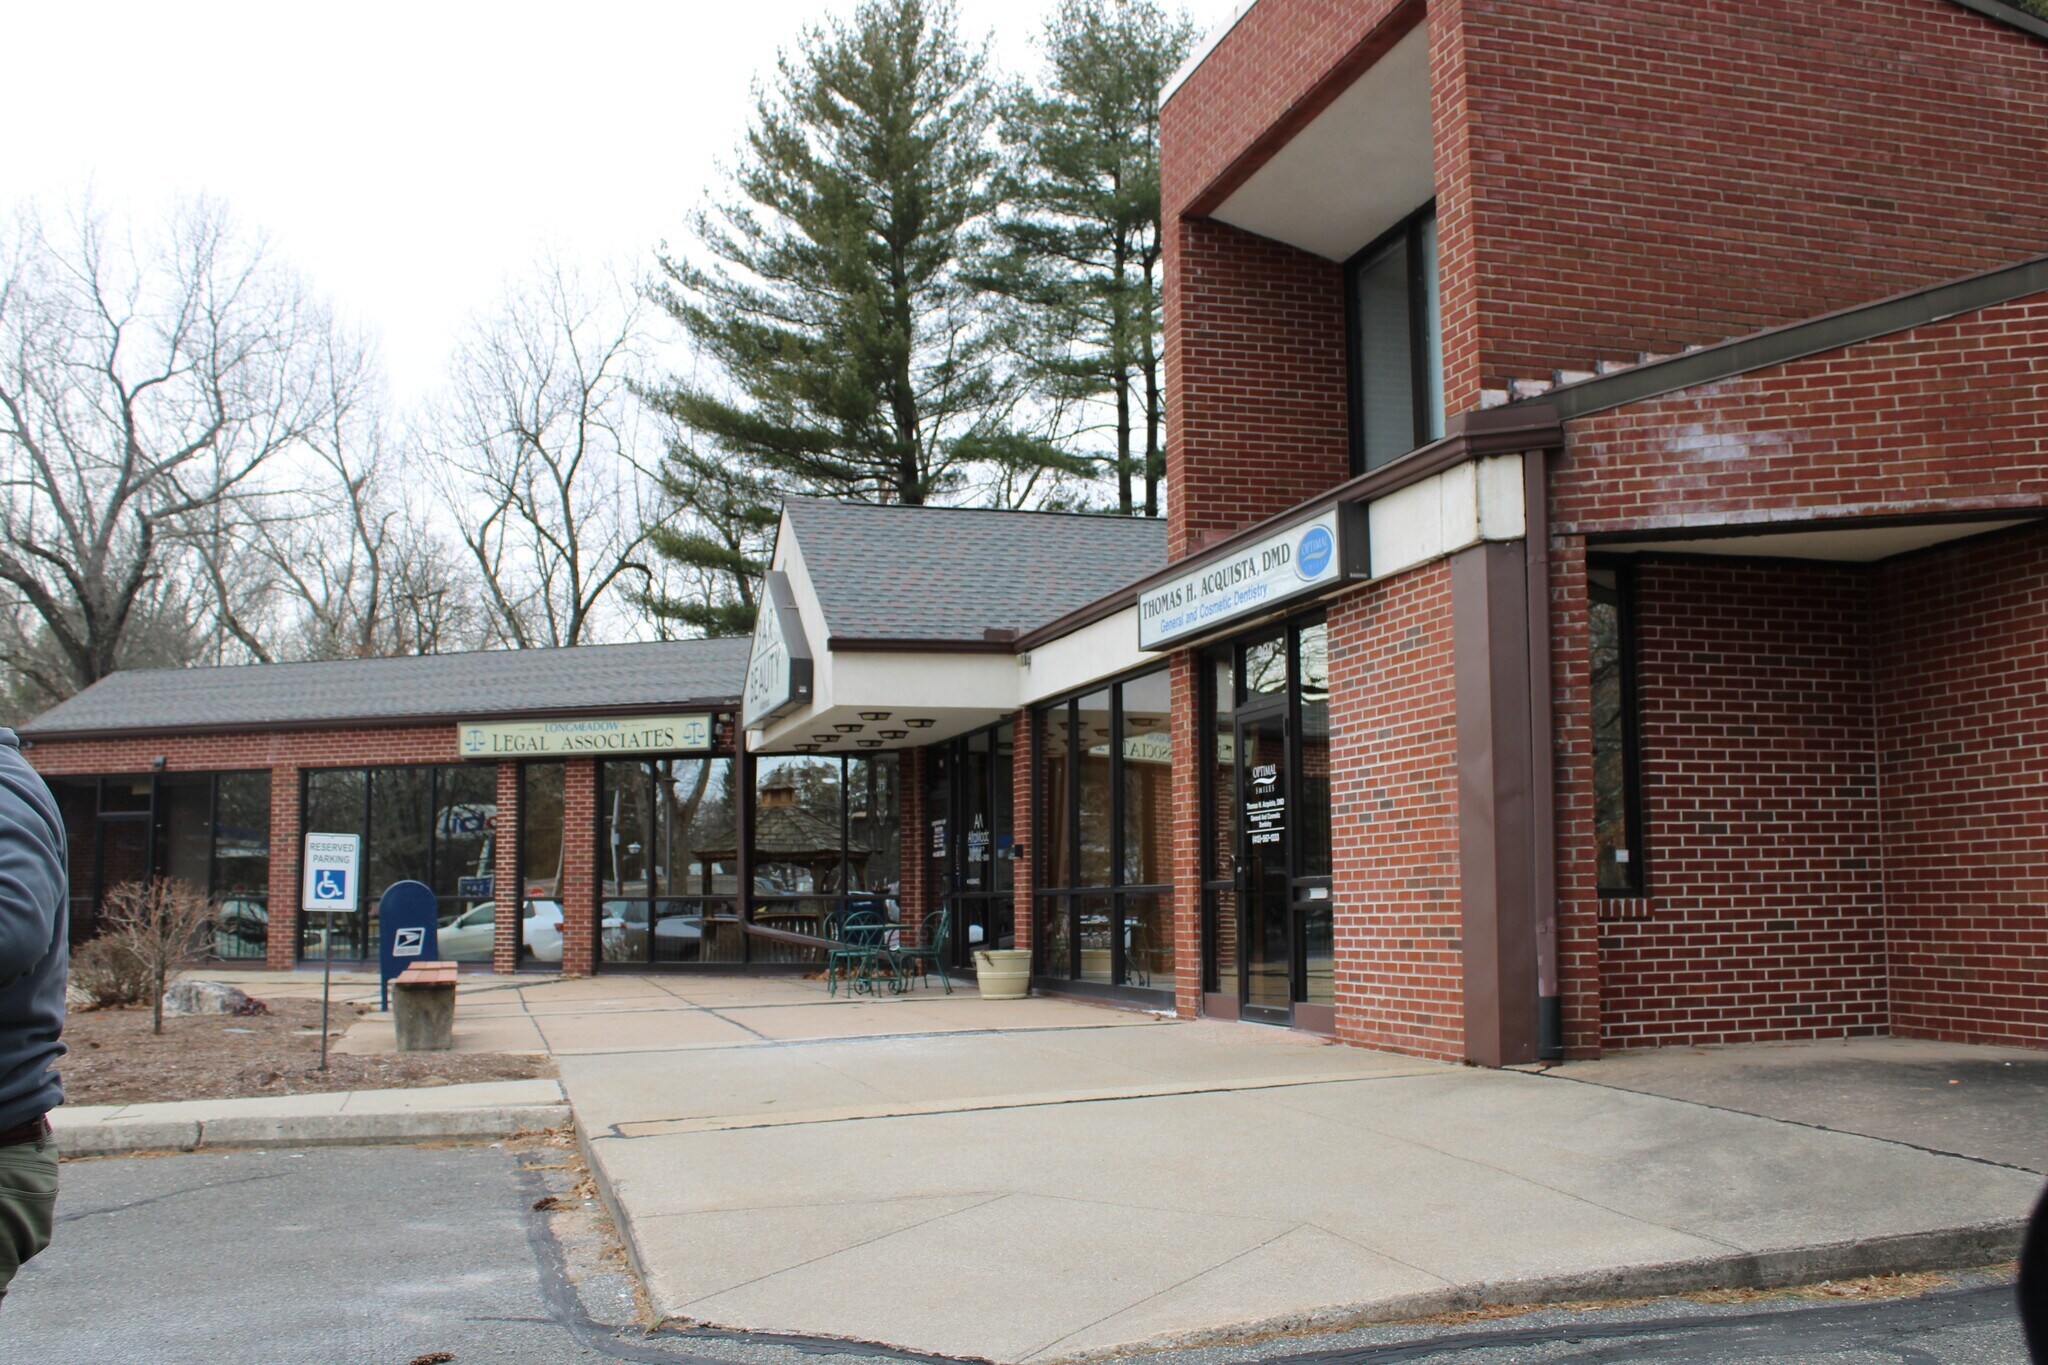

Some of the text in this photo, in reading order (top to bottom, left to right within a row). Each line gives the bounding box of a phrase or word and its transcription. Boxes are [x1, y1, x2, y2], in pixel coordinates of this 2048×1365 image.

[1301, 535, 1328, 556] OPTIMAL
[1143, 543, 1291, 620] THOMAS H. ACQUISTA, DMD
[1161, 583, 1267, 633] General and Cosmetic Dentistry
[750, 647, 781, 704] BEAUTY
[544, 721, 620, 733] LONGMEADOW
[493, 727, 675, 752] LEGAL ASSOCIATES
[1252, 763, 1277, 778] OPTIMAL
[1255, 784, 1275, 794] SMILES
[310, 843, 354, 852] RESERVED
[313, 854, 350, 864] PARKING
